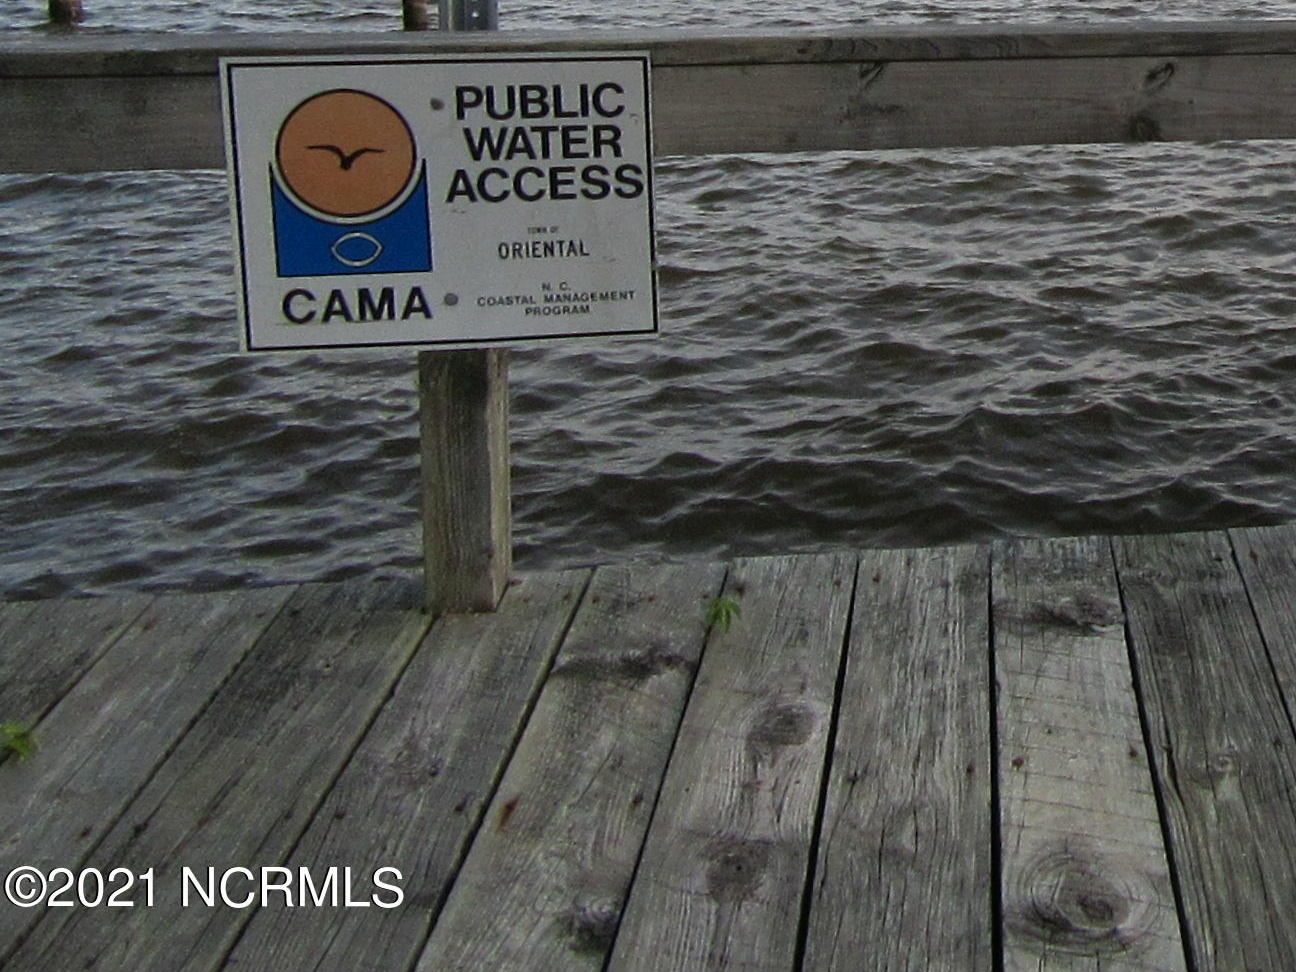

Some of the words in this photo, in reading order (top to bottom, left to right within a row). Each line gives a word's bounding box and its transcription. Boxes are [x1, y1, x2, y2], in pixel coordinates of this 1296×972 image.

[456, 82, 625, 120] PUBLIC
[463, 124, 623, 161] WATER
[446, 164, 645, 203] ACCESS
[498, 239, 590, 260] ORIENTAL
[281, 286, 433, 325] CAMA
[477, 295, 537, 307] COASTAL
[543, 291, 636, 304] MANAGEMENT
[525, 305, 591, 317] PROGRAM
